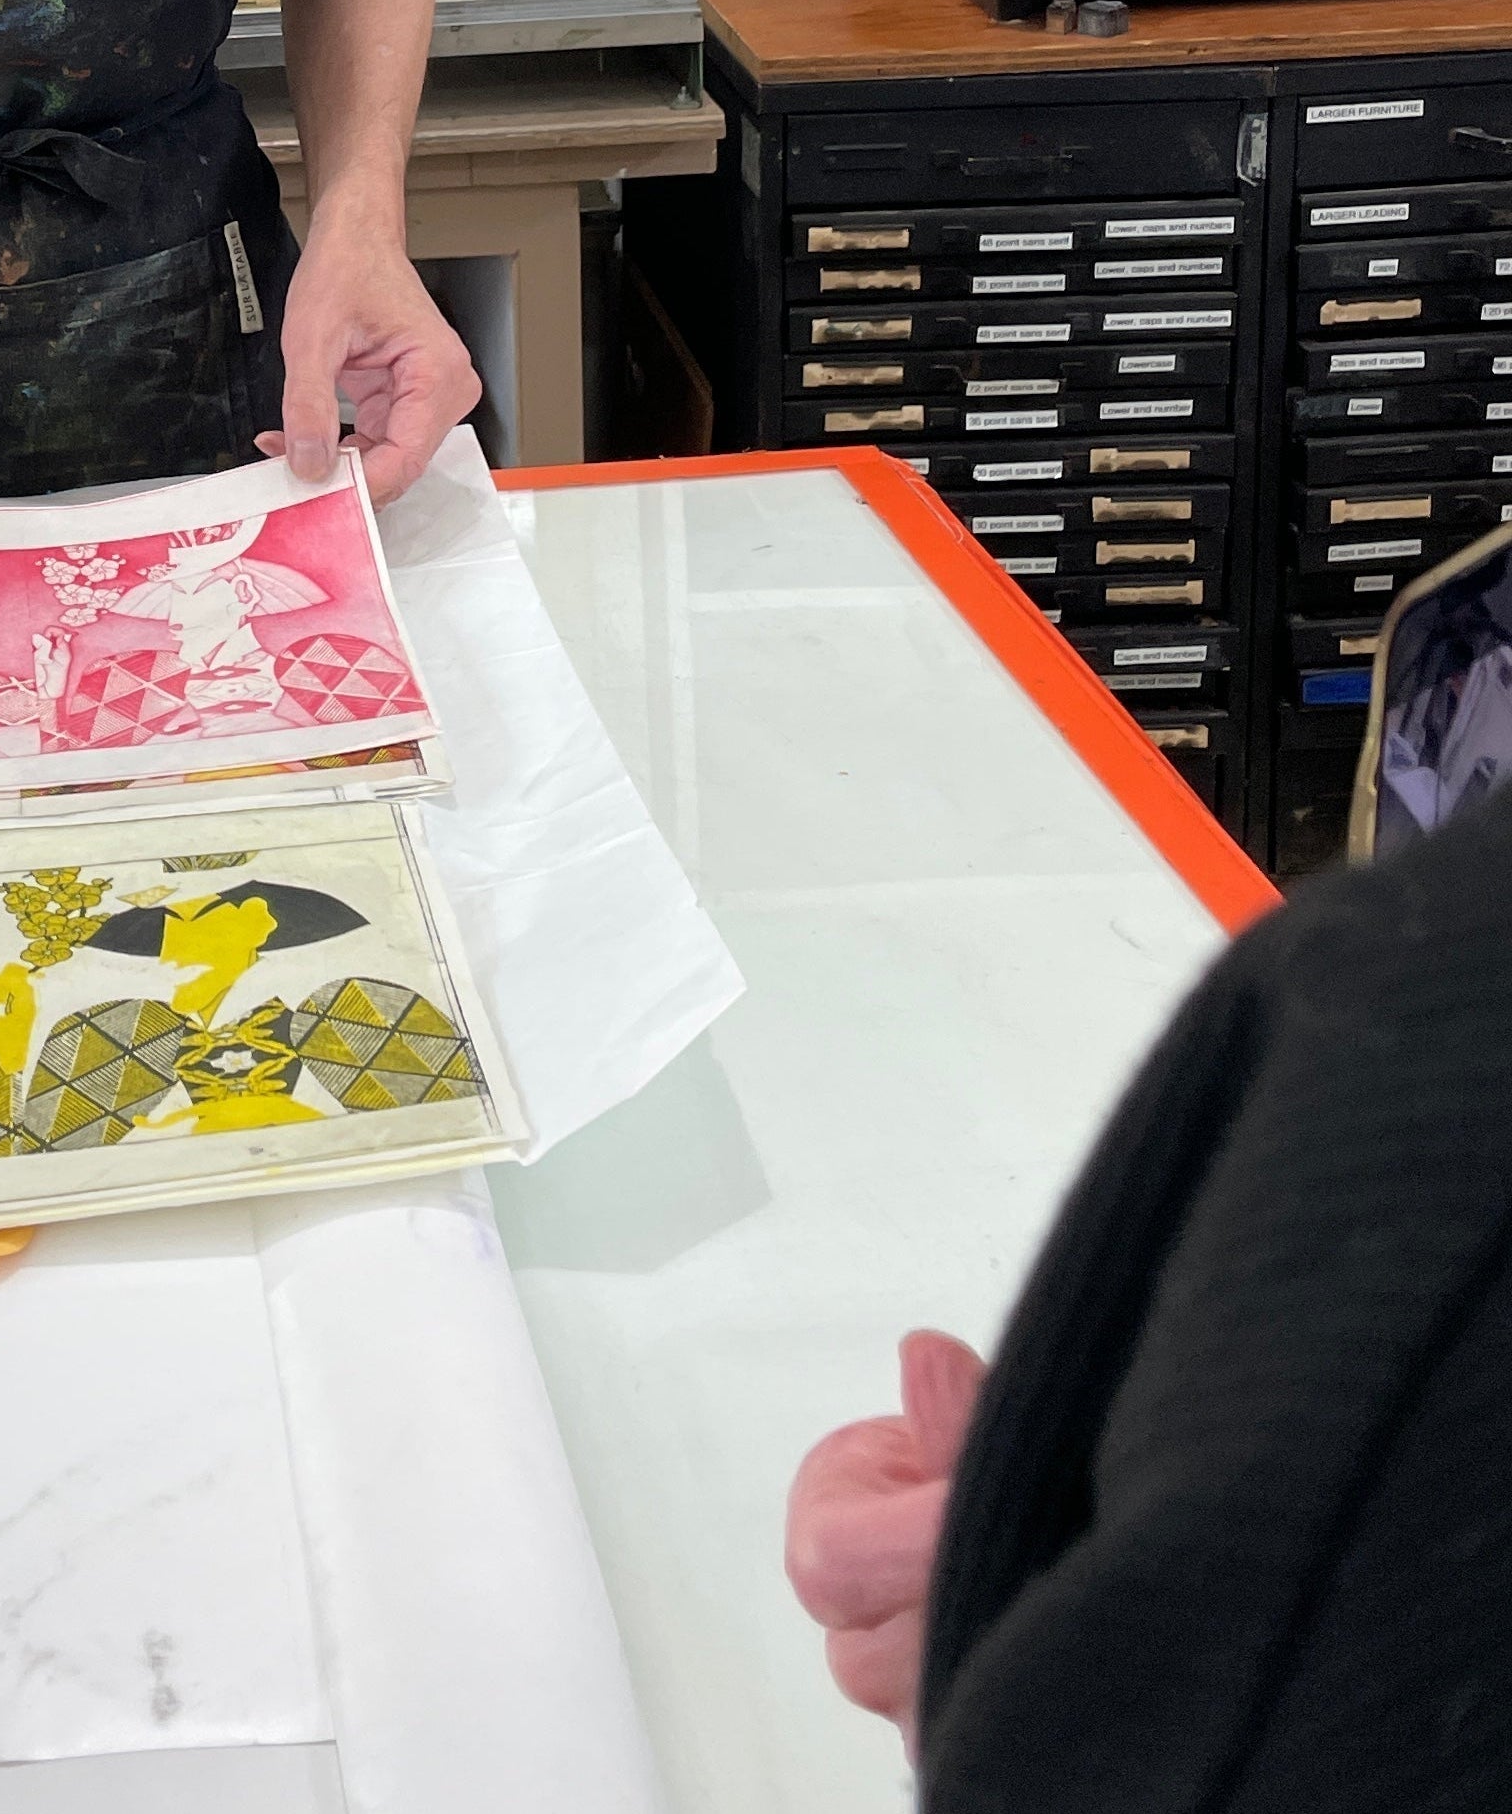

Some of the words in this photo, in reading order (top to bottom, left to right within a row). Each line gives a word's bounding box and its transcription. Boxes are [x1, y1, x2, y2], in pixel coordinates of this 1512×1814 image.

[1311, 107, 1356, 120] LARGER
[1358, 103, 1421, 116] FURNITURE
[1312, 210, 1356, 222] LARGER
[1358, 207, 1407, 218] LEADING
[1169, 223, 1187, 231] and
[230, 233, 245, 272] TABLE
[1157, 264, 1176, 272] and
[242, 295, 256, 322] SUR
[1166, 316, 1185, 325] and
[1187, 315, 1229, 324] numbers
[1121, 360, 1173, 370] Lowercase
[1359, 357, 1378, 366] and
[1134, 405, 1152, 414] and
